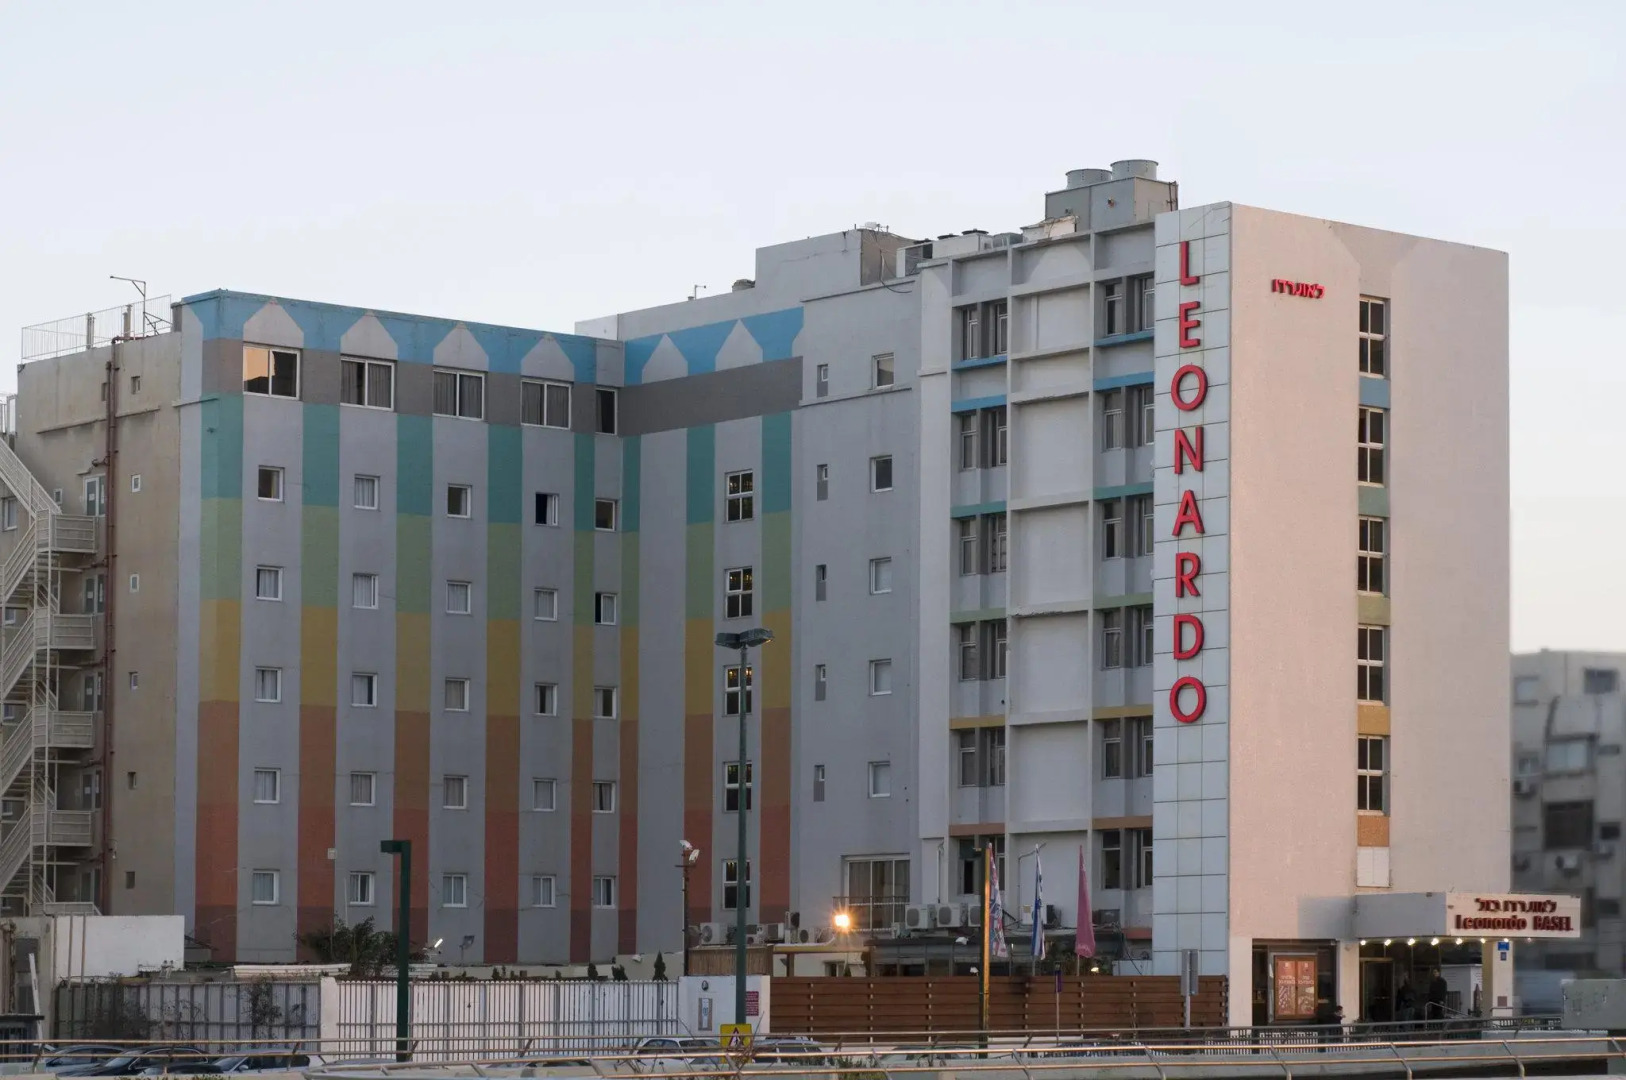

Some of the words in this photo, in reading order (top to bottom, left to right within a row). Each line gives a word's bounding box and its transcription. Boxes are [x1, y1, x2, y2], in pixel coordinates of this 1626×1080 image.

[1271, 279, 1325, 299] לאונרדו
[1170, 241, 1208, 723] LEONARDO
[1455, 915, 1527, 930] Leonardo
[1532, 916, 1573, 931] BASEL
